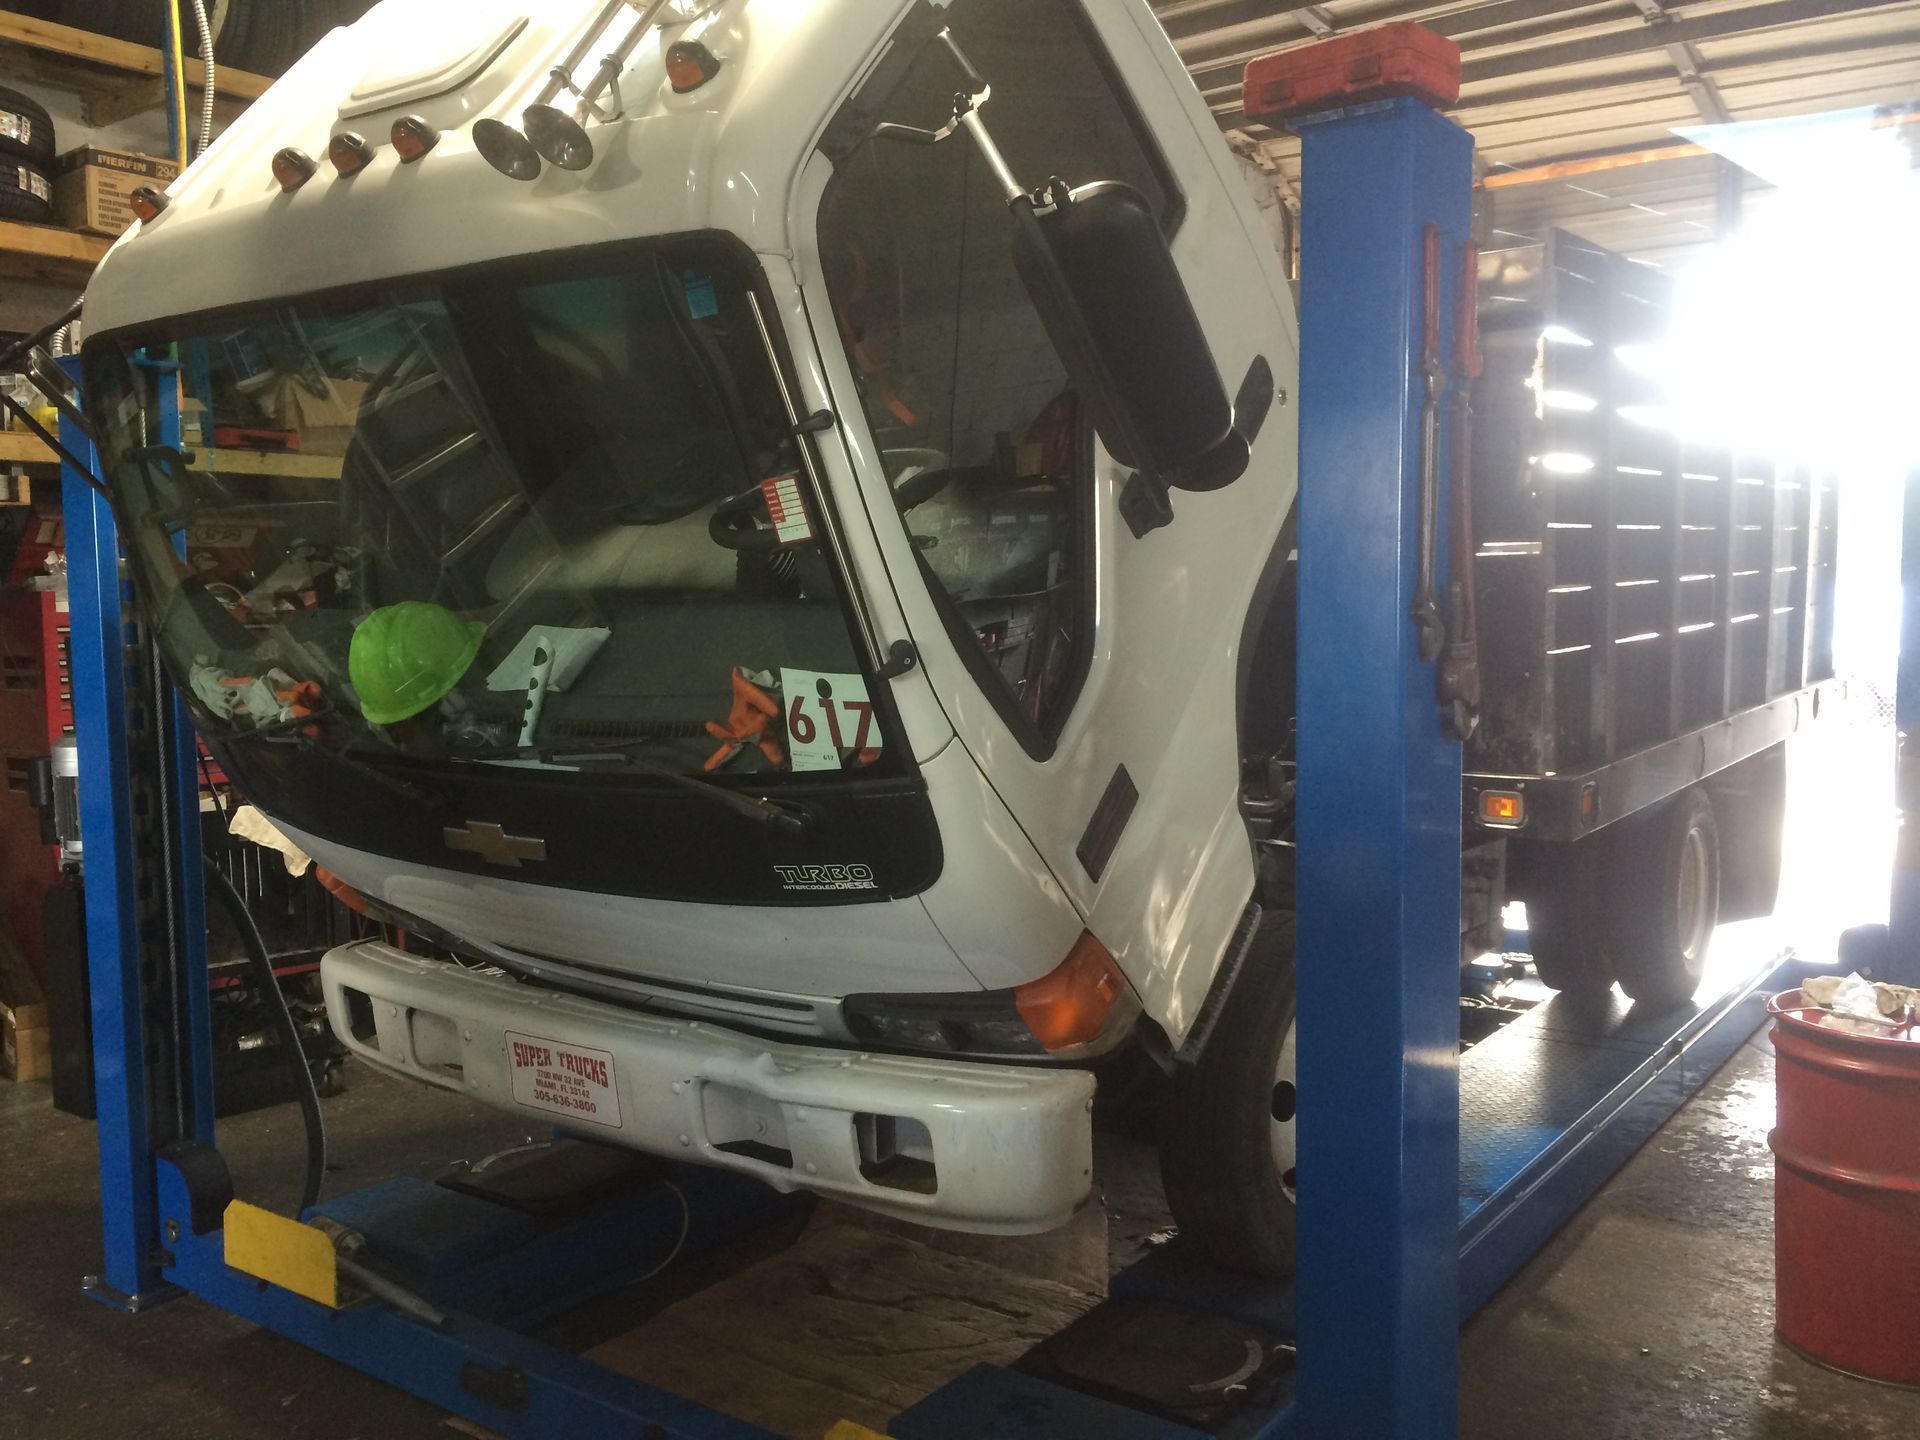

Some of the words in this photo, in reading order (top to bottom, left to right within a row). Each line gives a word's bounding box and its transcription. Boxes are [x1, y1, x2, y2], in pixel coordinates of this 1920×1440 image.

[97, 154, 147, 172] MERFIN
[789, 695, 873, 749] 617
[774, 864, 874, 883] TURBO
[835, 881, 879, 890] DIESEL
[513, 1042, 552, 1068] SUPER
[557, 1050, 609, 1088] TRUCKS
[561, 1084, 569, 1094] FL
[574, 1077, 586, 1088] AVE
[533, 1089, 597, 1113] 305-636-3800
